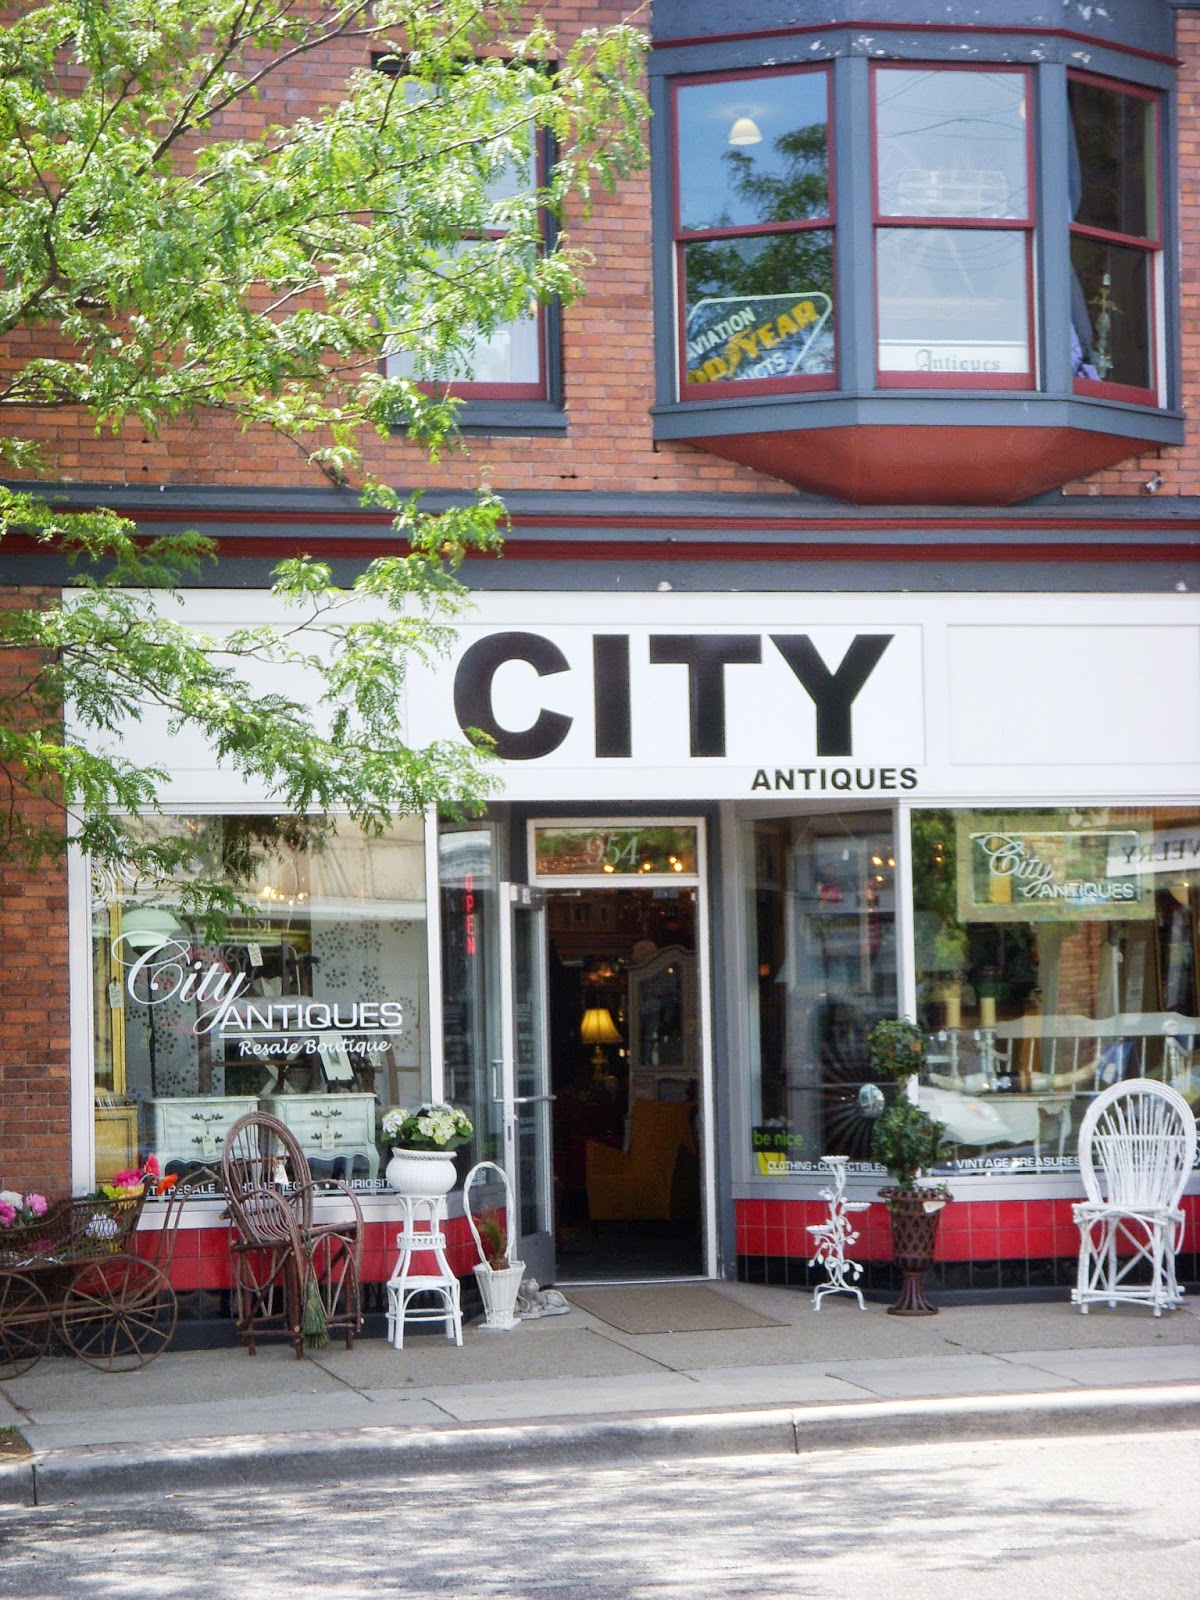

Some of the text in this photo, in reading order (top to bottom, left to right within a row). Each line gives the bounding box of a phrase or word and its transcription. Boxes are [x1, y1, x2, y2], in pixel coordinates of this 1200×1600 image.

[915, 348, 1001, 372] Antiques
[453, 631, 896, 761] CITY
[751, 767, 918, 791] ANTIQUES
[586, 836, 640, 866] 954
[976, 833, 1056, 898] City
[1038, 882, 1135, 899] ANTIQUES
[464, 872, 476, 955] OPEN
[111, 930, 251, 1035] City
[219, 1001, 404, 1031] ANTIQUES
[239, 1038, 393, 1058] Resale Boutique
[754, 1130, 772, 1145] be
[767, 1160, 813, 1171] CLOTHING
[956, 1157, 1009, 1169] VINTAGE
